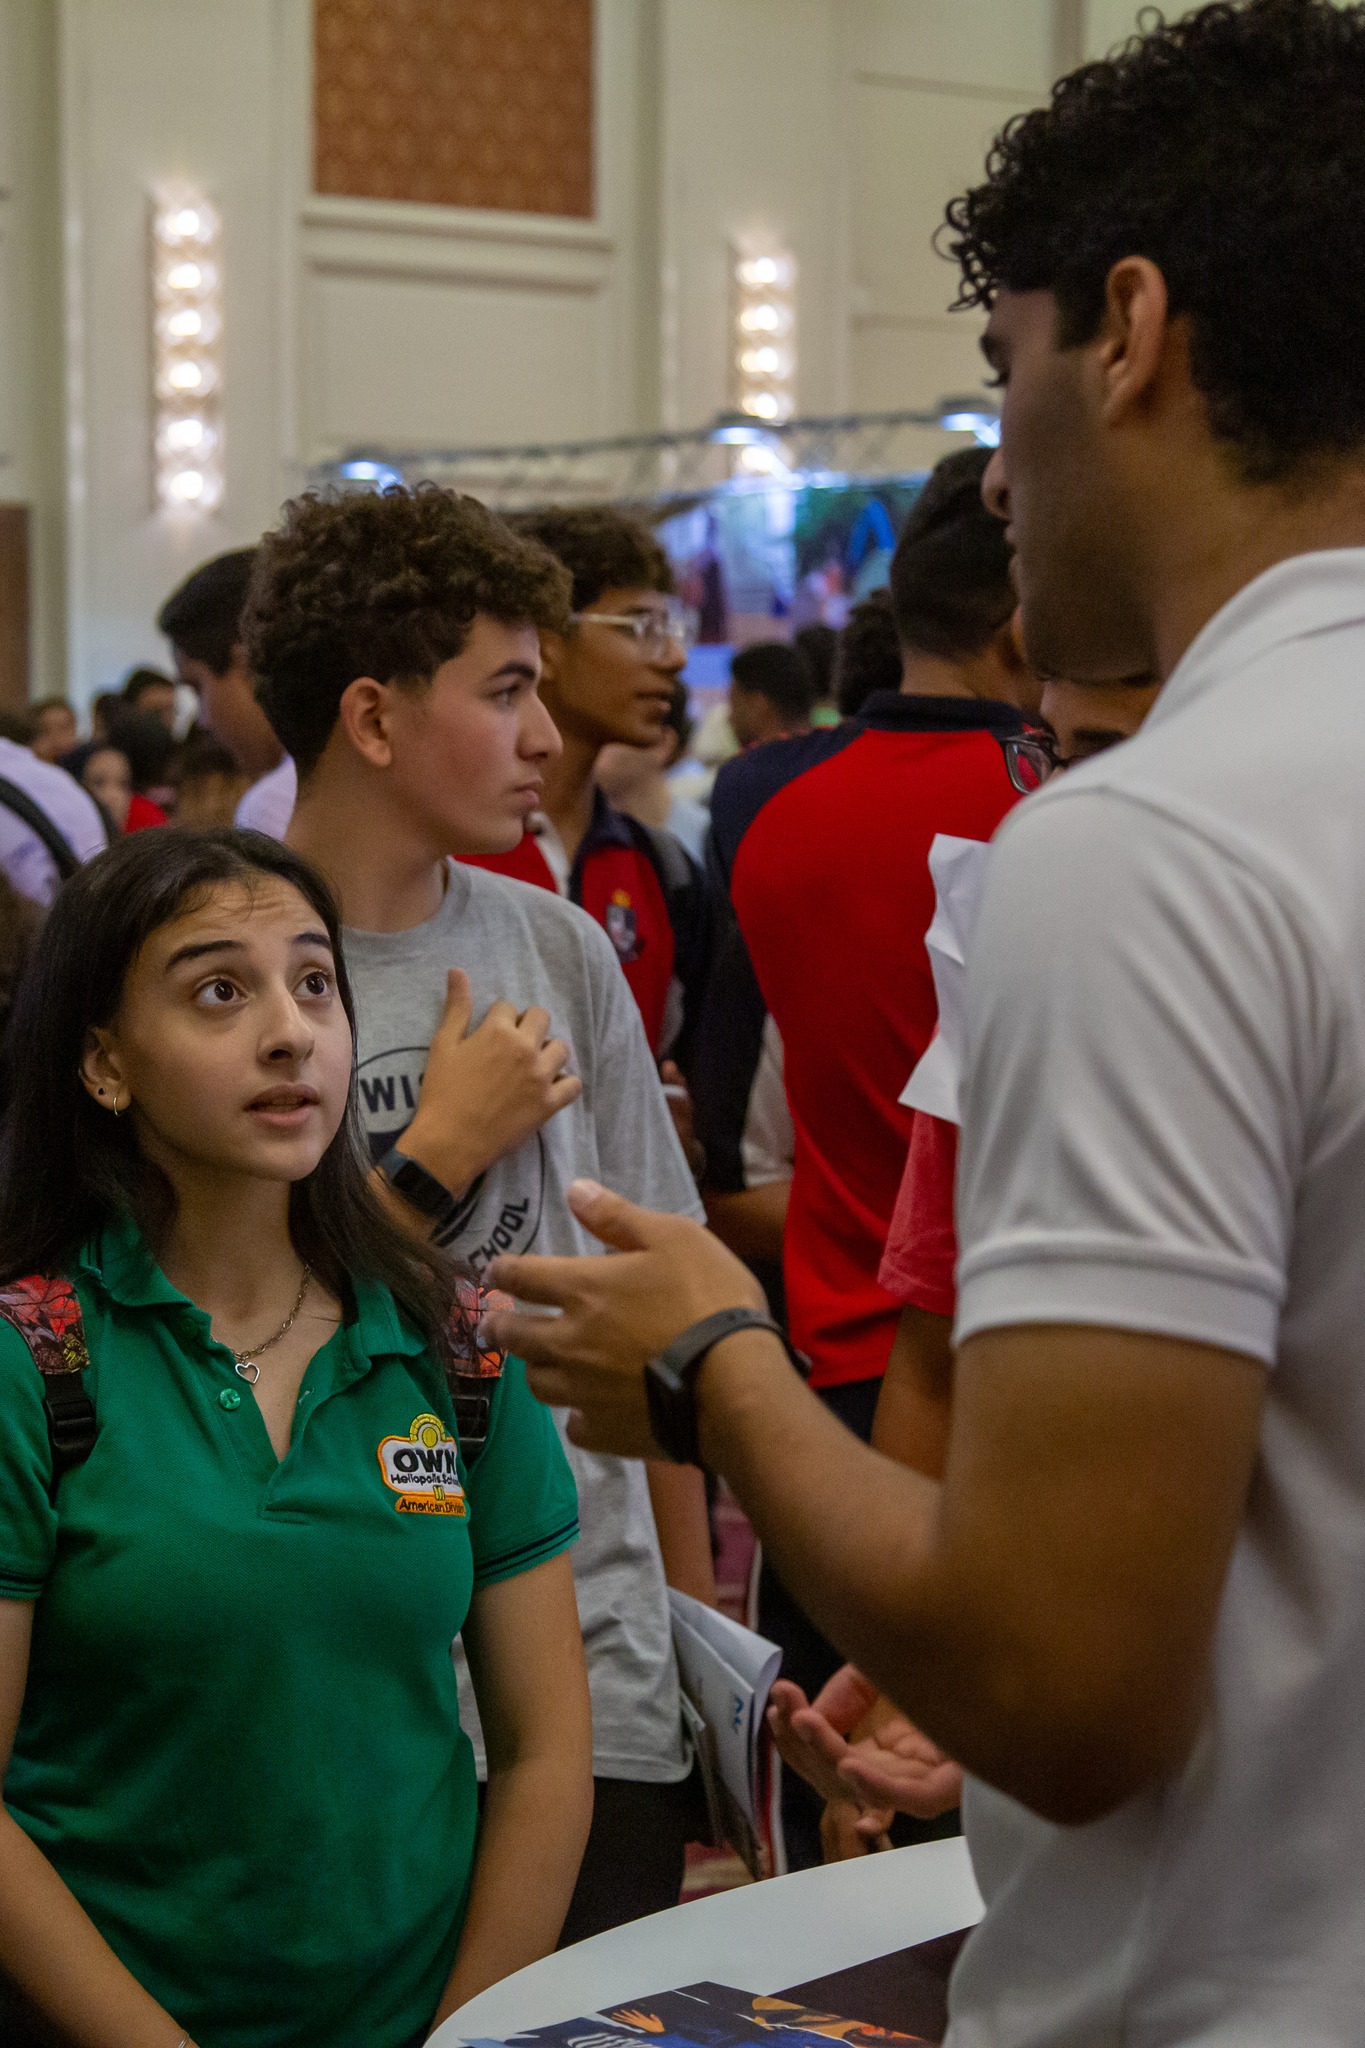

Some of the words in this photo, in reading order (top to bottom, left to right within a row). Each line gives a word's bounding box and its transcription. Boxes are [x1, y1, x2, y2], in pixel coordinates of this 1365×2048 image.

[468, 1198, 529, 1275] CHOOL
[393, 1448, 457, 1475] OWN
[390, 1473, 442, 1487] Heliopolis
[399, 1498, 445, 1513] American
